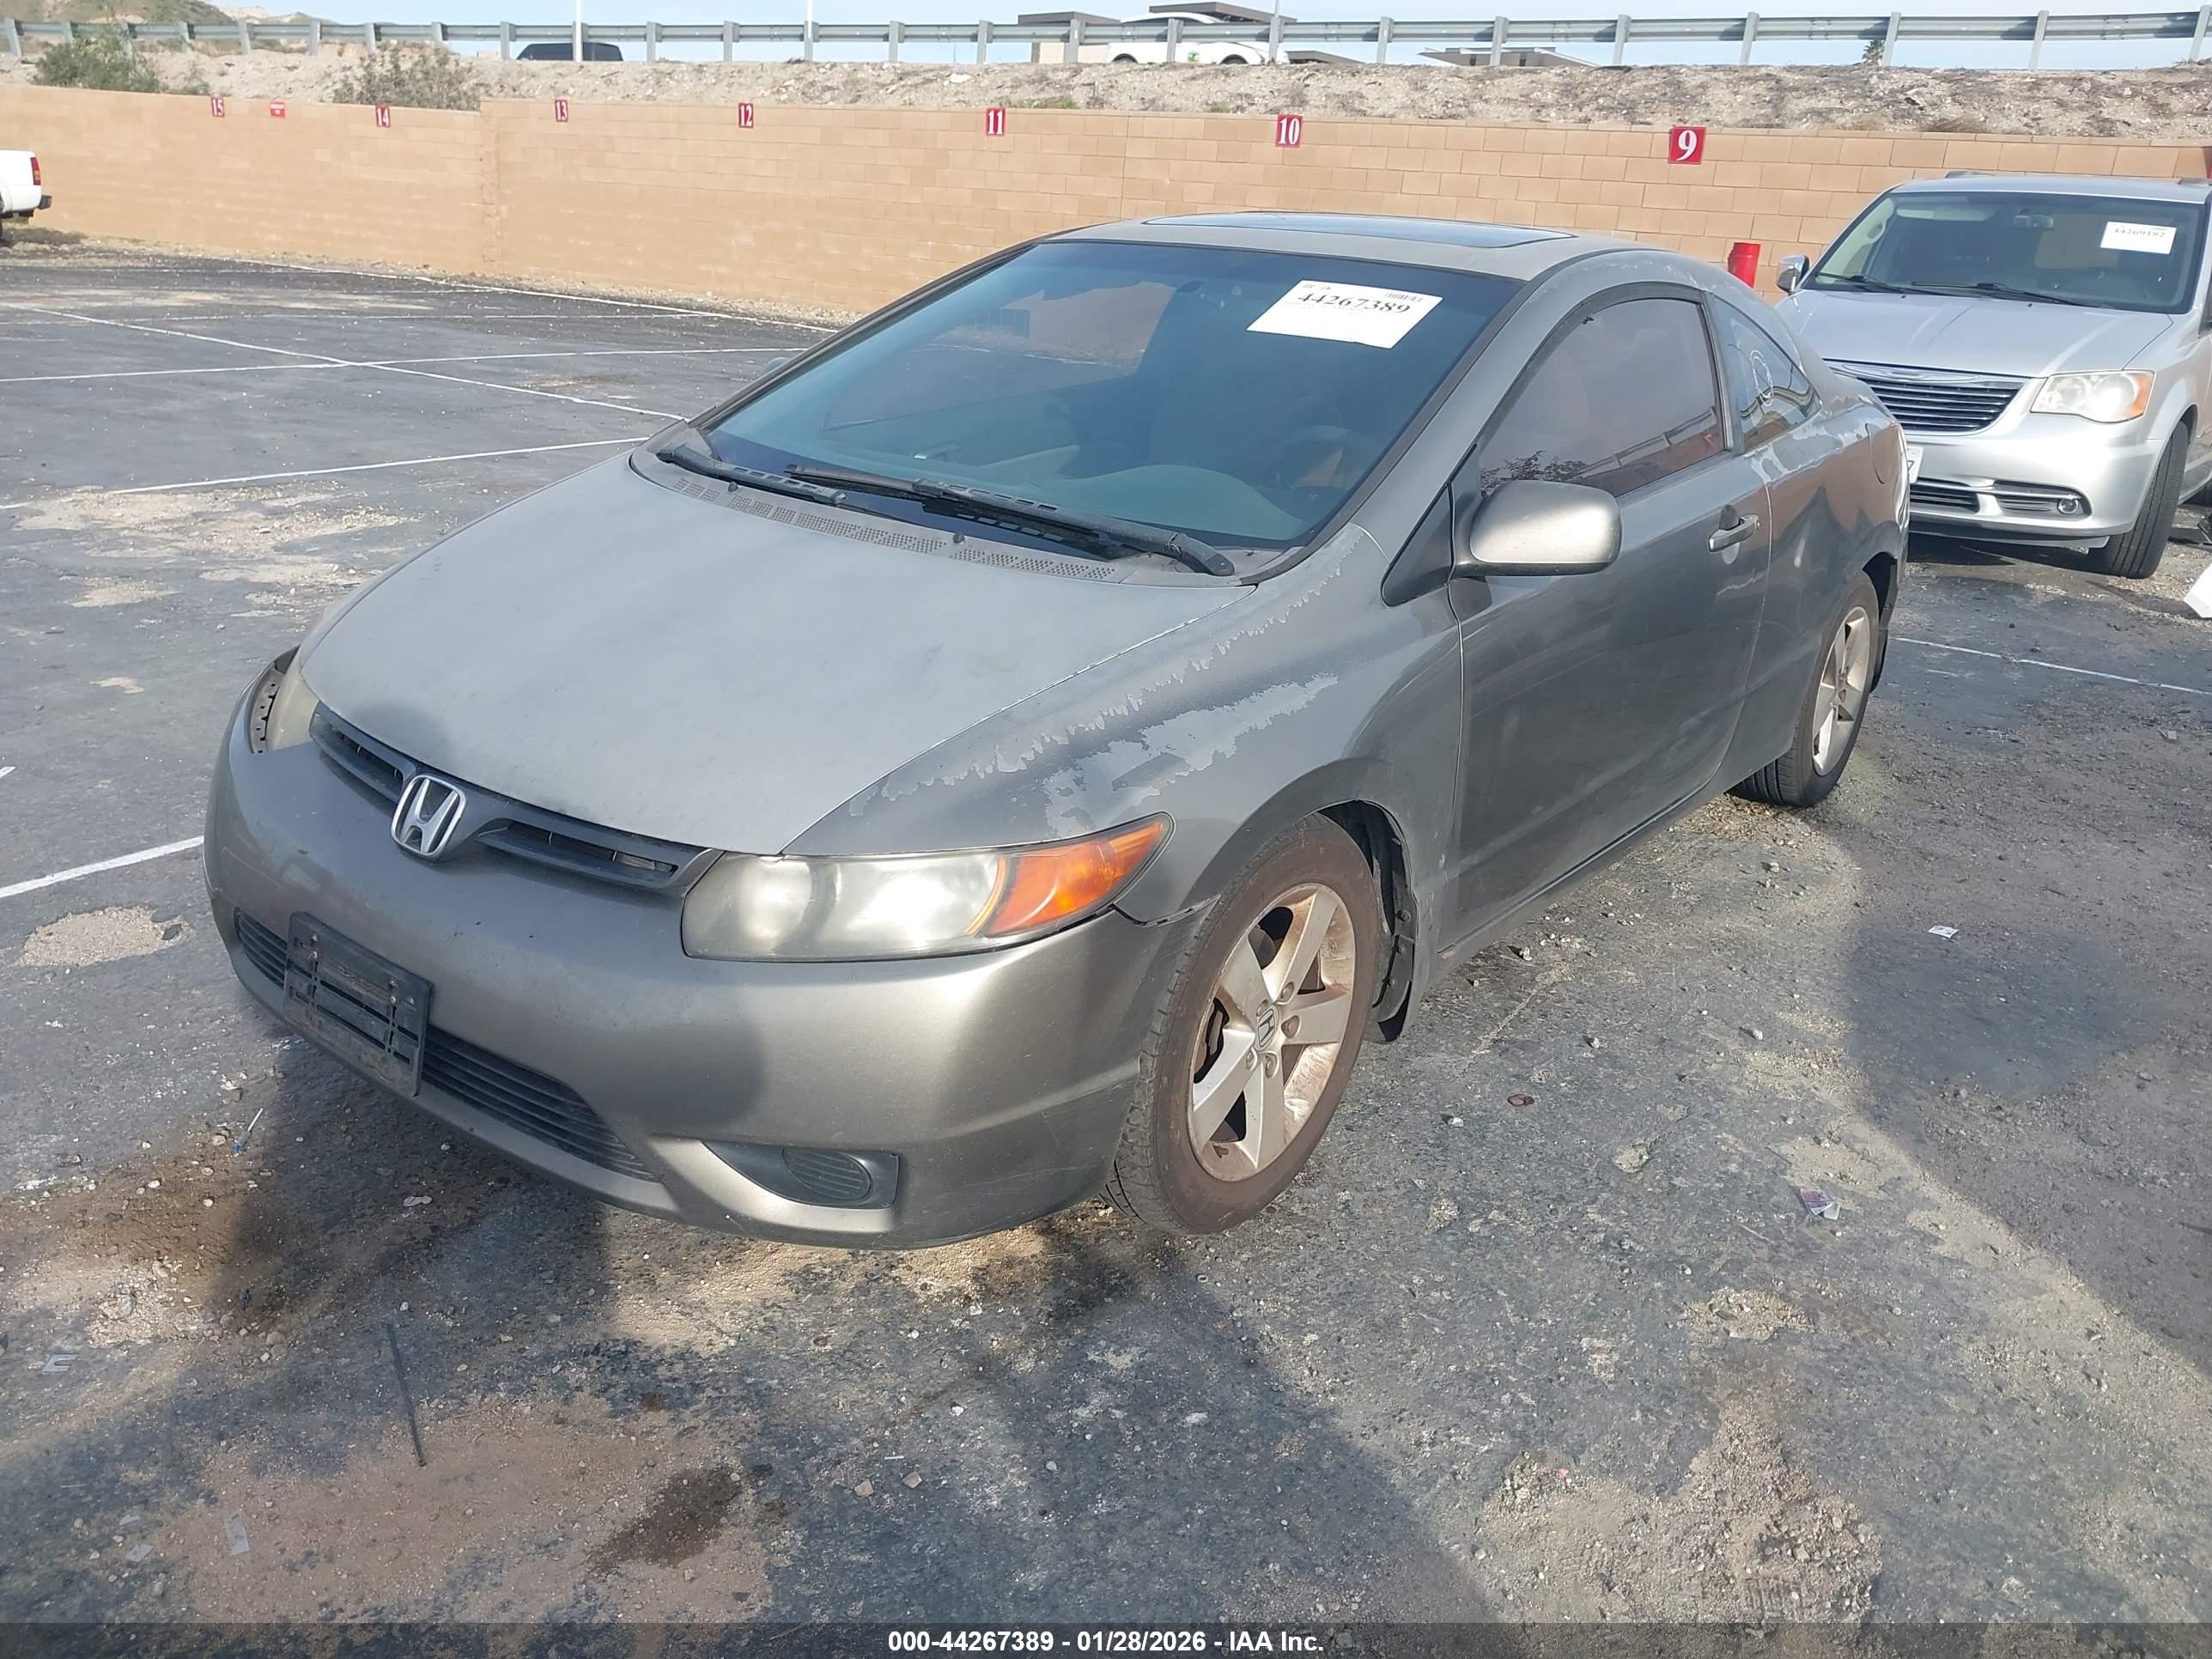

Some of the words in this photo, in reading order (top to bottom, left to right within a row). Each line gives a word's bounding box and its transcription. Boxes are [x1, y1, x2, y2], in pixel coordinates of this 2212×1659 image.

[212, 99, 224, 116] 15
[378, 107, 389, 126] 14
[556, 101, 568, 121] 13
[740, 105, 752, 126] 12
[988, 110, 1003, 135] 11
[1278, 117, 1300, 145] 10
[1675, 130, 1698, 161] 9
[1297, 292, 1411, 314] 44267389
